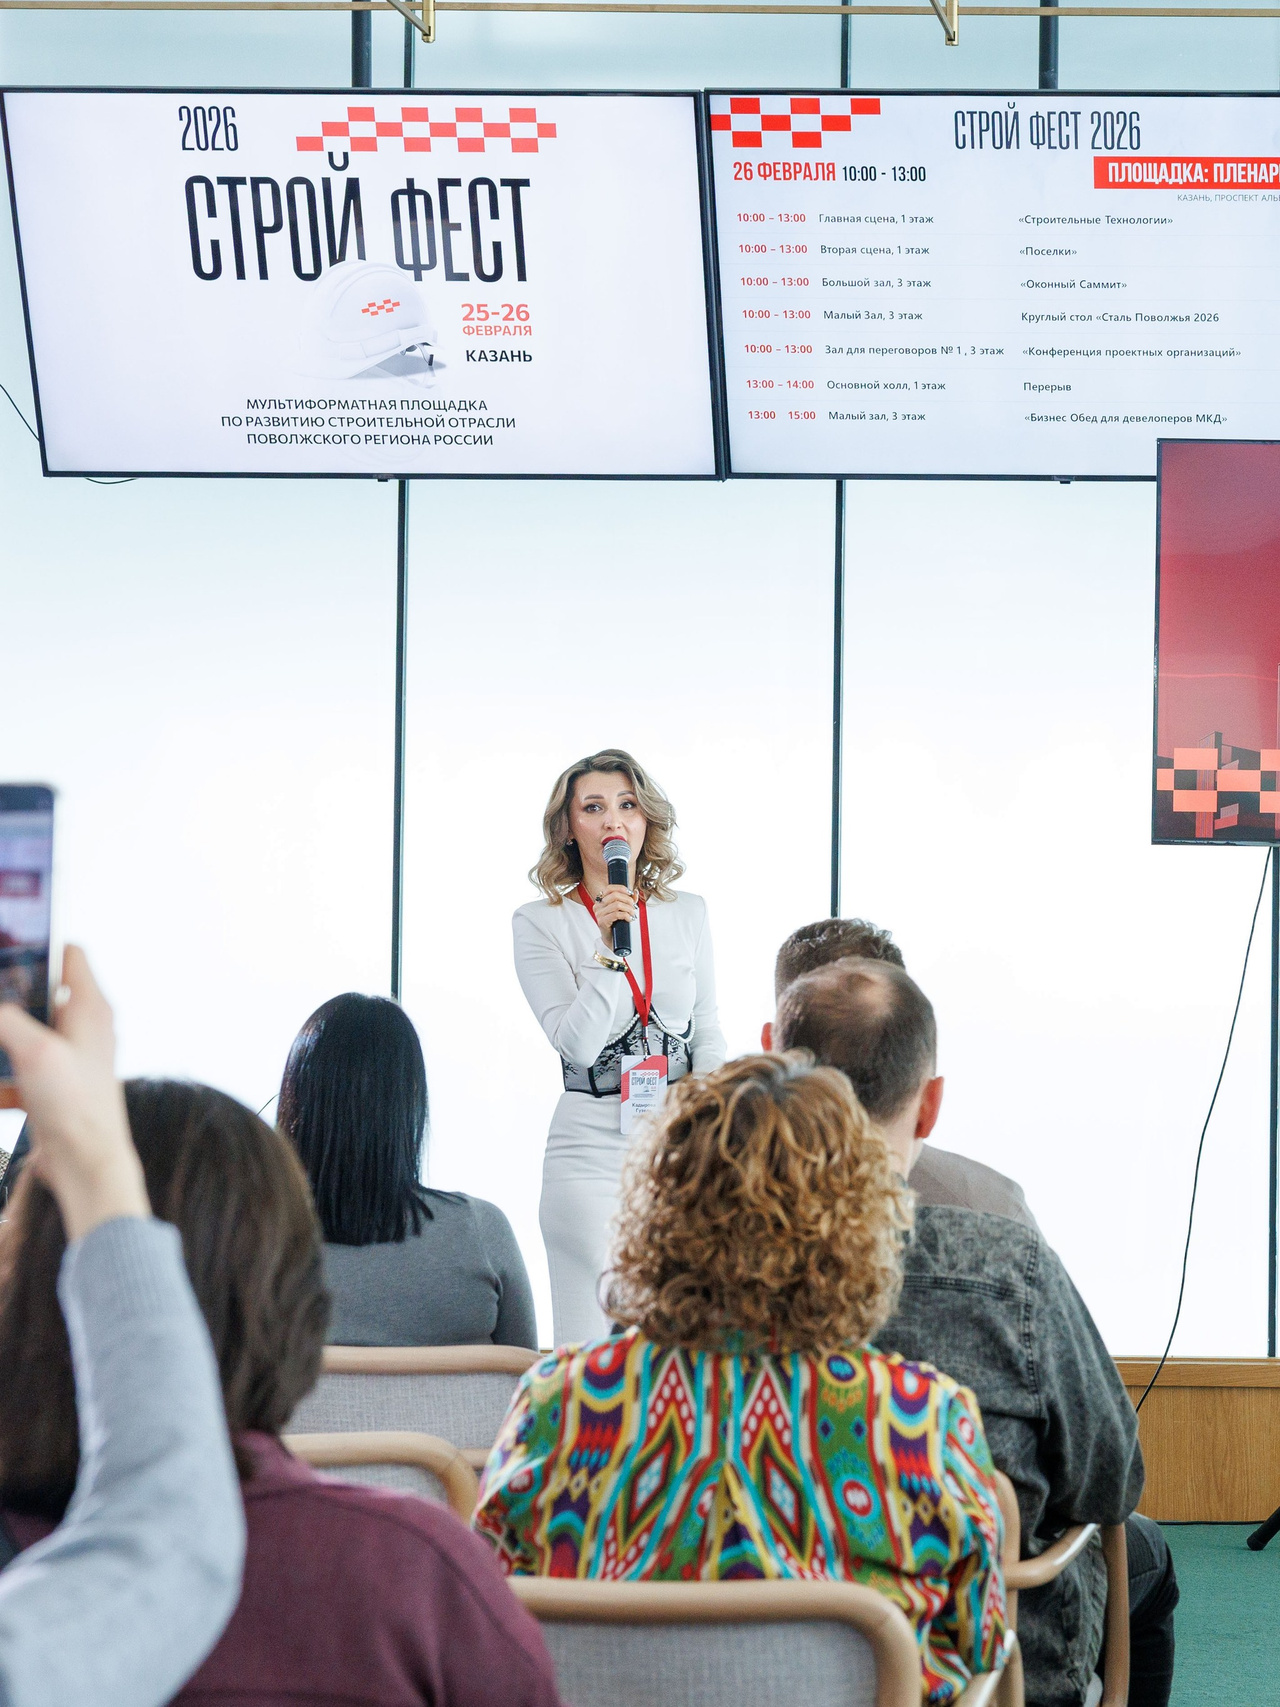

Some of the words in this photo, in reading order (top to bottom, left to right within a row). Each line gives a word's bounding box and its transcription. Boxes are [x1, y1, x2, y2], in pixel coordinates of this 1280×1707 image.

[179, 106, 238, 151] 2026
[955, 102, 1019, 149] СТРОЙ
[1030, 111, 1081, 150] ФЕСТ
[1091, 111, 1140, 150] 2026
[734, 162, 753, 180] 26
[758, 162, 835, 181] ФЕВРАЛЯ
[842, 165, 877, 182] 10:00
[891, 165, 927, 182] 13:00
[1109, 163, 1208, 184] ПЛОЩАДКА:
[1177, 193, 1213, 203] КАЗАНЬ,
[1214, 193, 1259, 203] ПРОСПЕКТ
[185, 152, 366, 281] СТРОЙ
[391, 177, 530, 282] ФЕСТ
[736, 212, 766, 223] 10:00
[777, 213, 806, 223] 13:00
[818, 213, 862, 223] Главная
[864, 215, 898, 225] сцена,
[908, 216, 934, 224] этаж
[1018, 214, 1102, 227] «Строительные
[1104, 214, 1174, 225] Технологии»
[738, 243, 767, 254] 10:00
[779, 244, 808, 254] 13:00
[820, 244, 857, 257] Вторая
[860, 247, 894, 256] сцена,
[904, 247, 930, 255] этаж
[1019, 246, 1078, 257] «Поселки»
[740, 276, 769, 287] 10:00
[780, 277, 810, 287] 13:00
[821, 277, 870, 288] Большой
[873, 280, 894, 289] зал,
[906, 280, 932, 288] этаж
[1020, 279, 1076, 289] «Оконный
[1079, 279, 1128, 289] Саммит»
[462, 304, 529, 321] 25-26
[742, 309, 771, 319] 10:00
[782, 309, 811, 319] 13:00
[823, 309, 862, 320] Малый
[864, 310, 886, 321] Зал,
[898, 312, 923, 320] этаж
[1021, 311, 1067, 324] Круглый
[1069, 314, 1093, 322] стол
[1095, 312, 1132, 322] «Сталь
[1135, 312, 1191, 322] Поволжья
[1193, 312, 1220, 323] 2026
[462, 324, 533, 337] ФЕВРАЛЯ
[744, 344, 773, 354] 10:00
[784, 344, 813, 354] 13:00
[825, 344, 844, 355] Зал
[846, 347, 866, 356] для
[868, 347, 938, 358] переговоров
[979, 348, 1005, 356] этаж
[1022, 346, 1102, 359] «Конференция
[1105, 349, 1163, 359] проектных
[1166, 347, 1242, 359] организаций»
[465, 349, 533, 363] КАЗАНЬ
[746, 379, 775, 389] 13:00
[786, 379, 815, 389] 14:00
[826, 380, 880, 390] Основной
[883, 382, 911, 391] холл,
[921, 382, 946, 390] этаж
[1023, 381, 1072, 394] Перерыв
[246, 398, 397, 411] МУЛЬТИФОРМАТНАЯ
[400, 399, 488, 413] ПЛОЩАДКА
[221, 415, 243, 427] ПО
[245, 416, 325, 428] РАЗВИТИЮ
[327, 414, 445, 428] СТРОИТЕЛЬНОЙ
[448, 417, 516, 429] ОТРАСЛИ
[748, 410, 777, 420] 13:00
[788, 410, 816, 420] 15:00
[828, 411, 867, 421] Малый
[868, 413, 889, 422] зал,
[901, 413, 926, 421] этаж
[1024, 412, 1067, 423] «Бизнес
[1070, 412, 1099, 424] Обед
[1100, 415, 1120, 424] для
[1122, 415, 1193, 425] девелоперов
[1195, 413, 1228, 425] МКД»
[246, 433, 362, 445] ПОВОЛЖСКОГО
[364, 434, 431, 446] РЕГИОНА
[433, 434, 494, 446] РОССИИ
[631, 1076, 645, 1085] СТРОЙ
[646, 1077, 657, 1085] ФЕСТ
